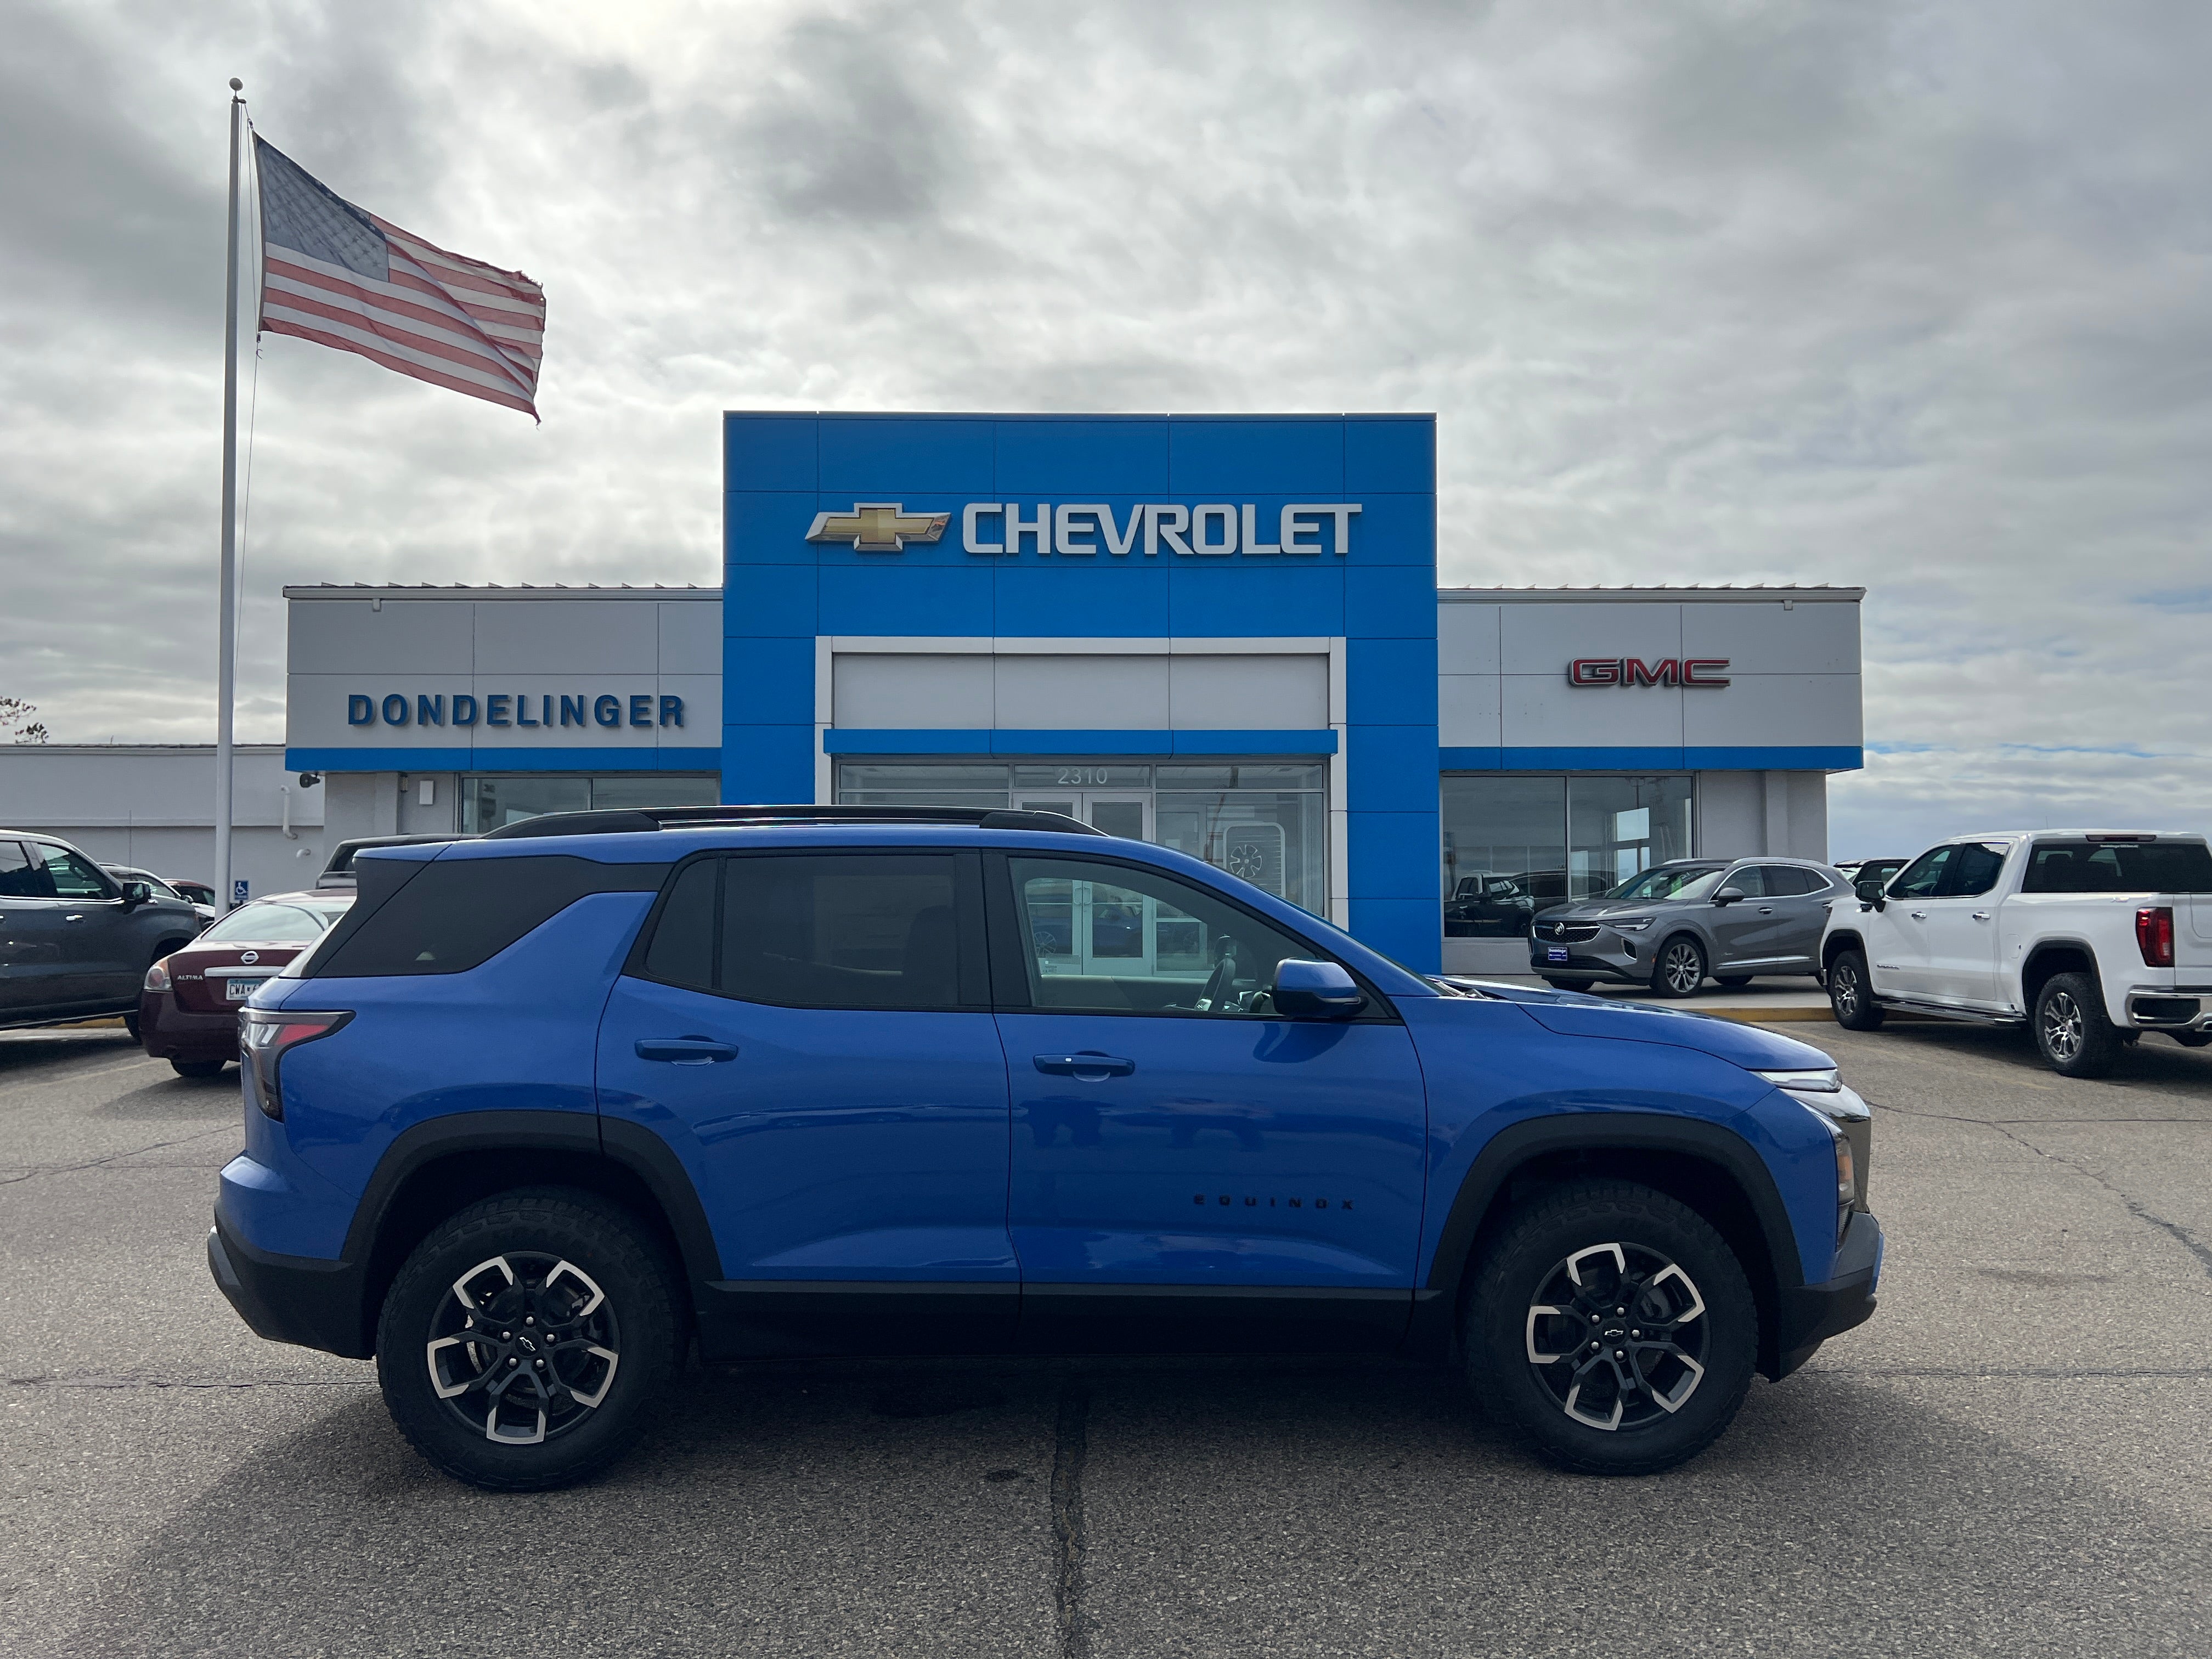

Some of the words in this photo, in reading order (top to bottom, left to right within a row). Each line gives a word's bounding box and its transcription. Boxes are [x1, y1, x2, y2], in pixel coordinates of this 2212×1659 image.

[962, 503, 1362, 555] CHEVROLET
[1568, 657, 1730, 687] GMC
[348, 693, 684, 727] DONDELINGER
[1057, 768, 1108, 785] 2310
[1193, 1194, 1354, 1210] EQUINOX
